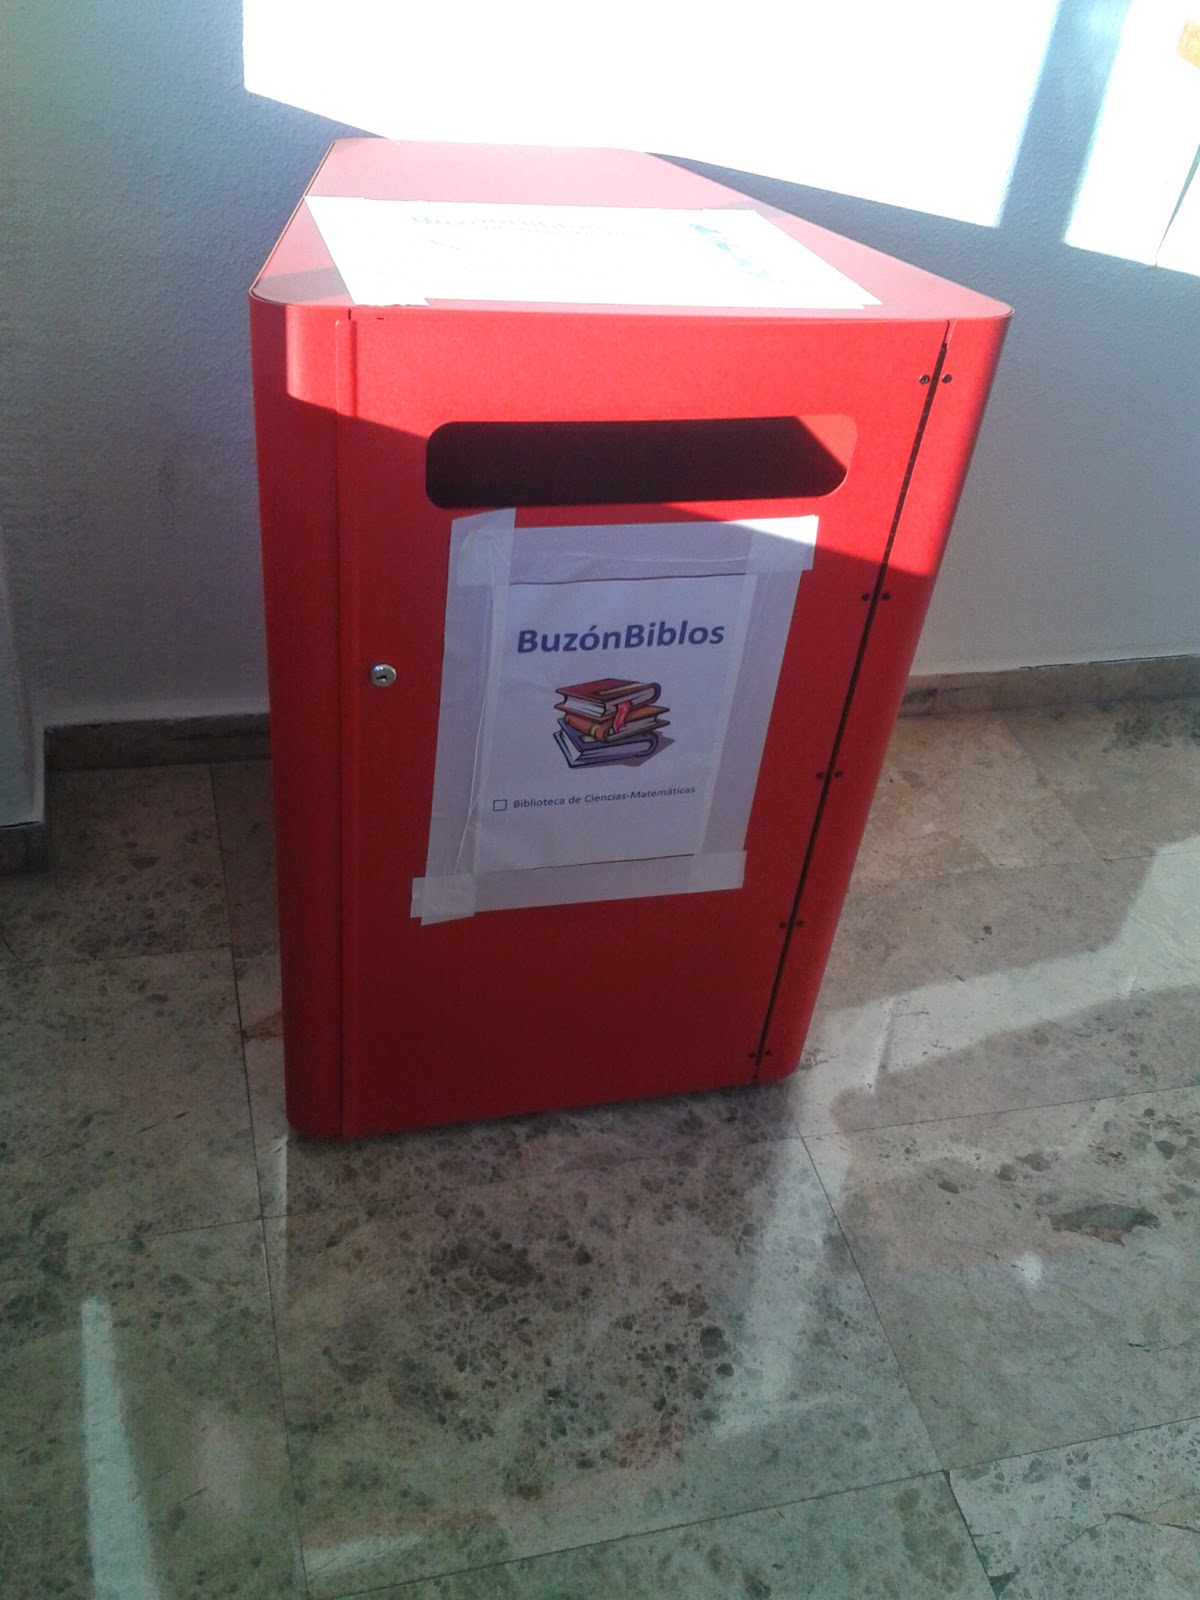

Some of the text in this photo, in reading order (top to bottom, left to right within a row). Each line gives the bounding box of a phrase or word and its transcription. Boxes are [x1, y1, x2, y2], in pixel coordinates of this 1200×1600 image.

[517, 620, 725, 654] BuzónBiblos
[513, 785, 696, 809] Biblioteca de Ciencias-Matemáticas
